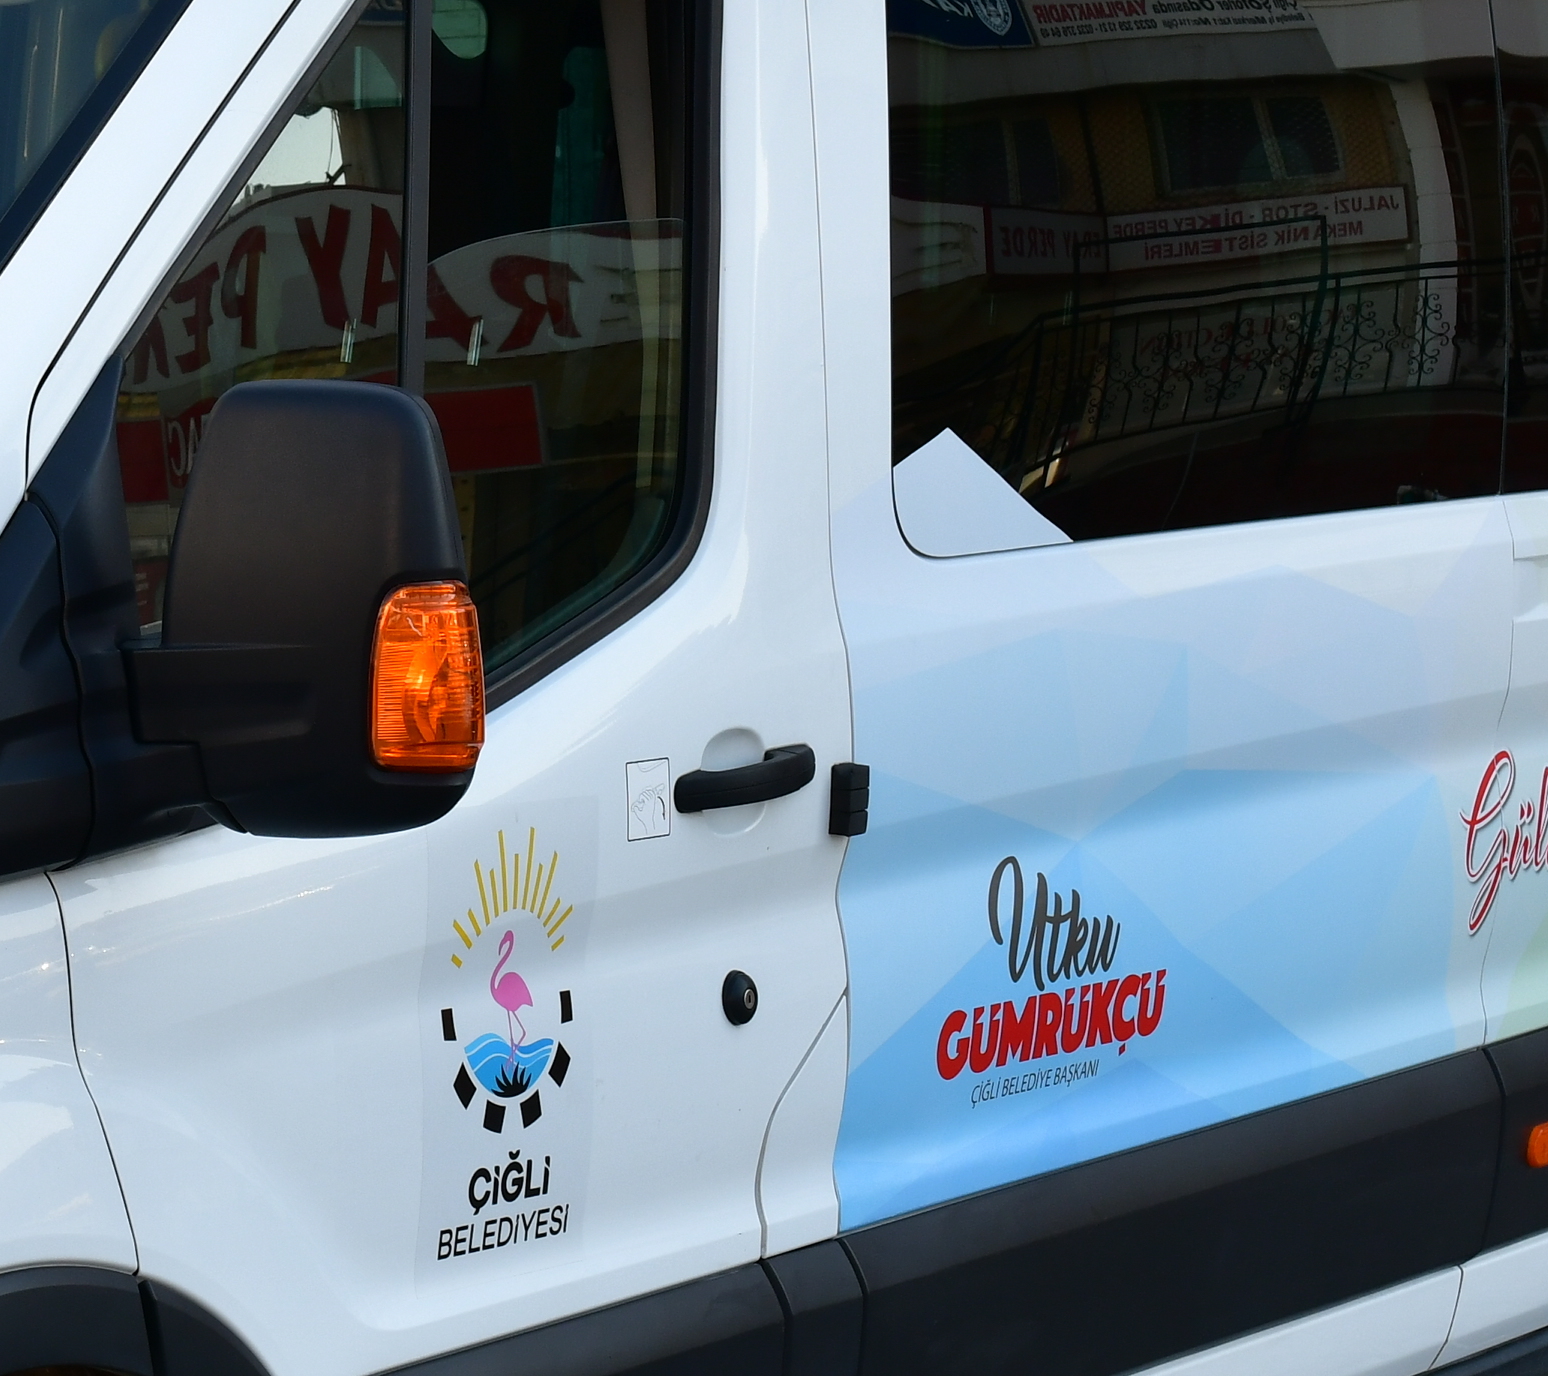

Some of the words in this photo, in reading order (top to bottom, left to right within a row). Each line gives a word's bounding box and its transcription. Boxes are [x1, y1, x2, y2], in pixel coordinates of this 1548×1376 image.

[988, 855, 1121, 992] Utku
[936, 969, 1167, 1080] GÜMRÜKÇÜ
[971, 1076, 1002, 1109] ÇİĞLİ
[1001, 1069, 1053, 1098] BELEDİYE
[1053, 1059, 1100, 1087] BAŞKANI
[468, 1149, 551, 1216] ÇİĞLİ
